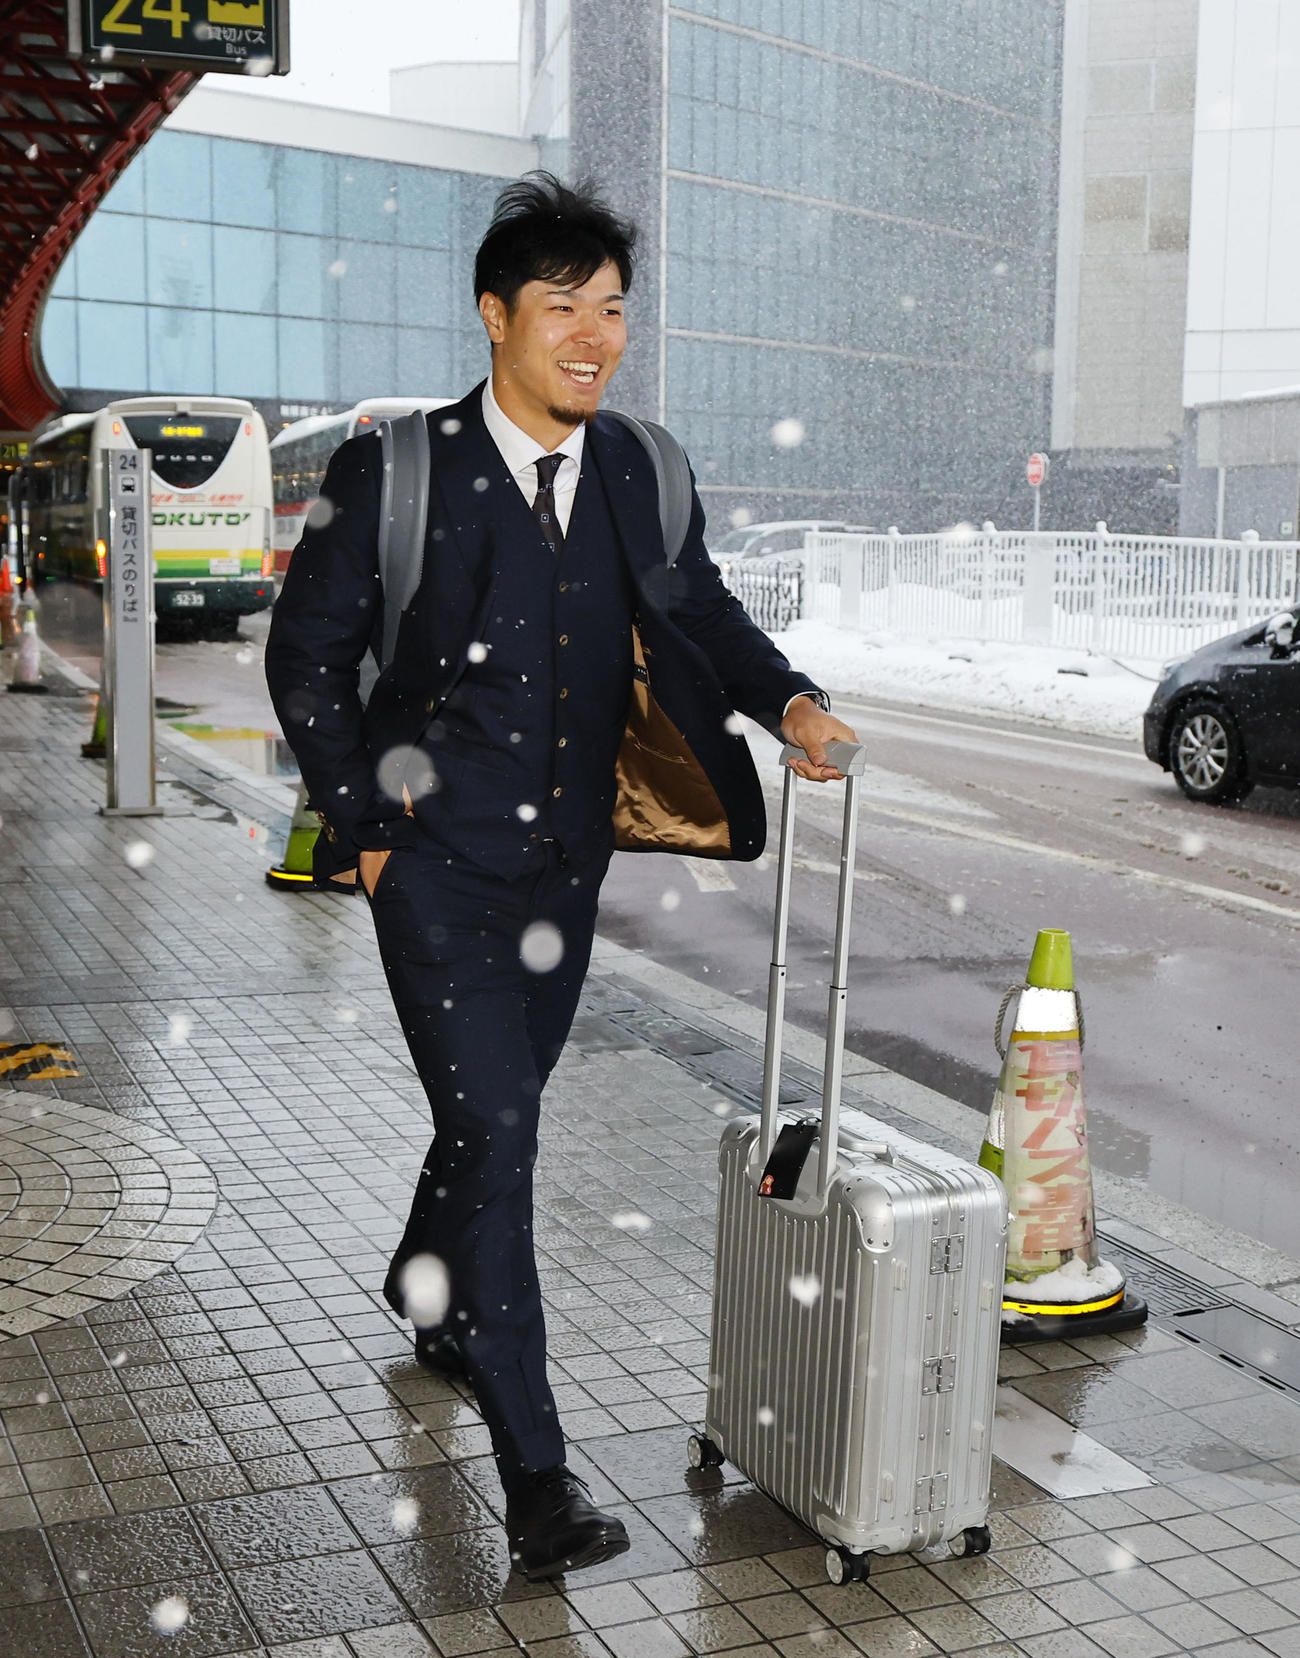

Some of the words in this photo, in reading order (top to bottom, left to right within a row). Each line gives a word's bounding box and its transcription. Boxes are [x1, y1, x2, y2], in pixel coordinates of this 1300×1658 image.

[101, 0, 190, 38] 24
[208, 26, 266, 44] 貸切バス
[226, 44, 247, 55] Bus
[120, 454, 137, 470] 24
[121, 506, 138, 612] 貸切バスのりば
